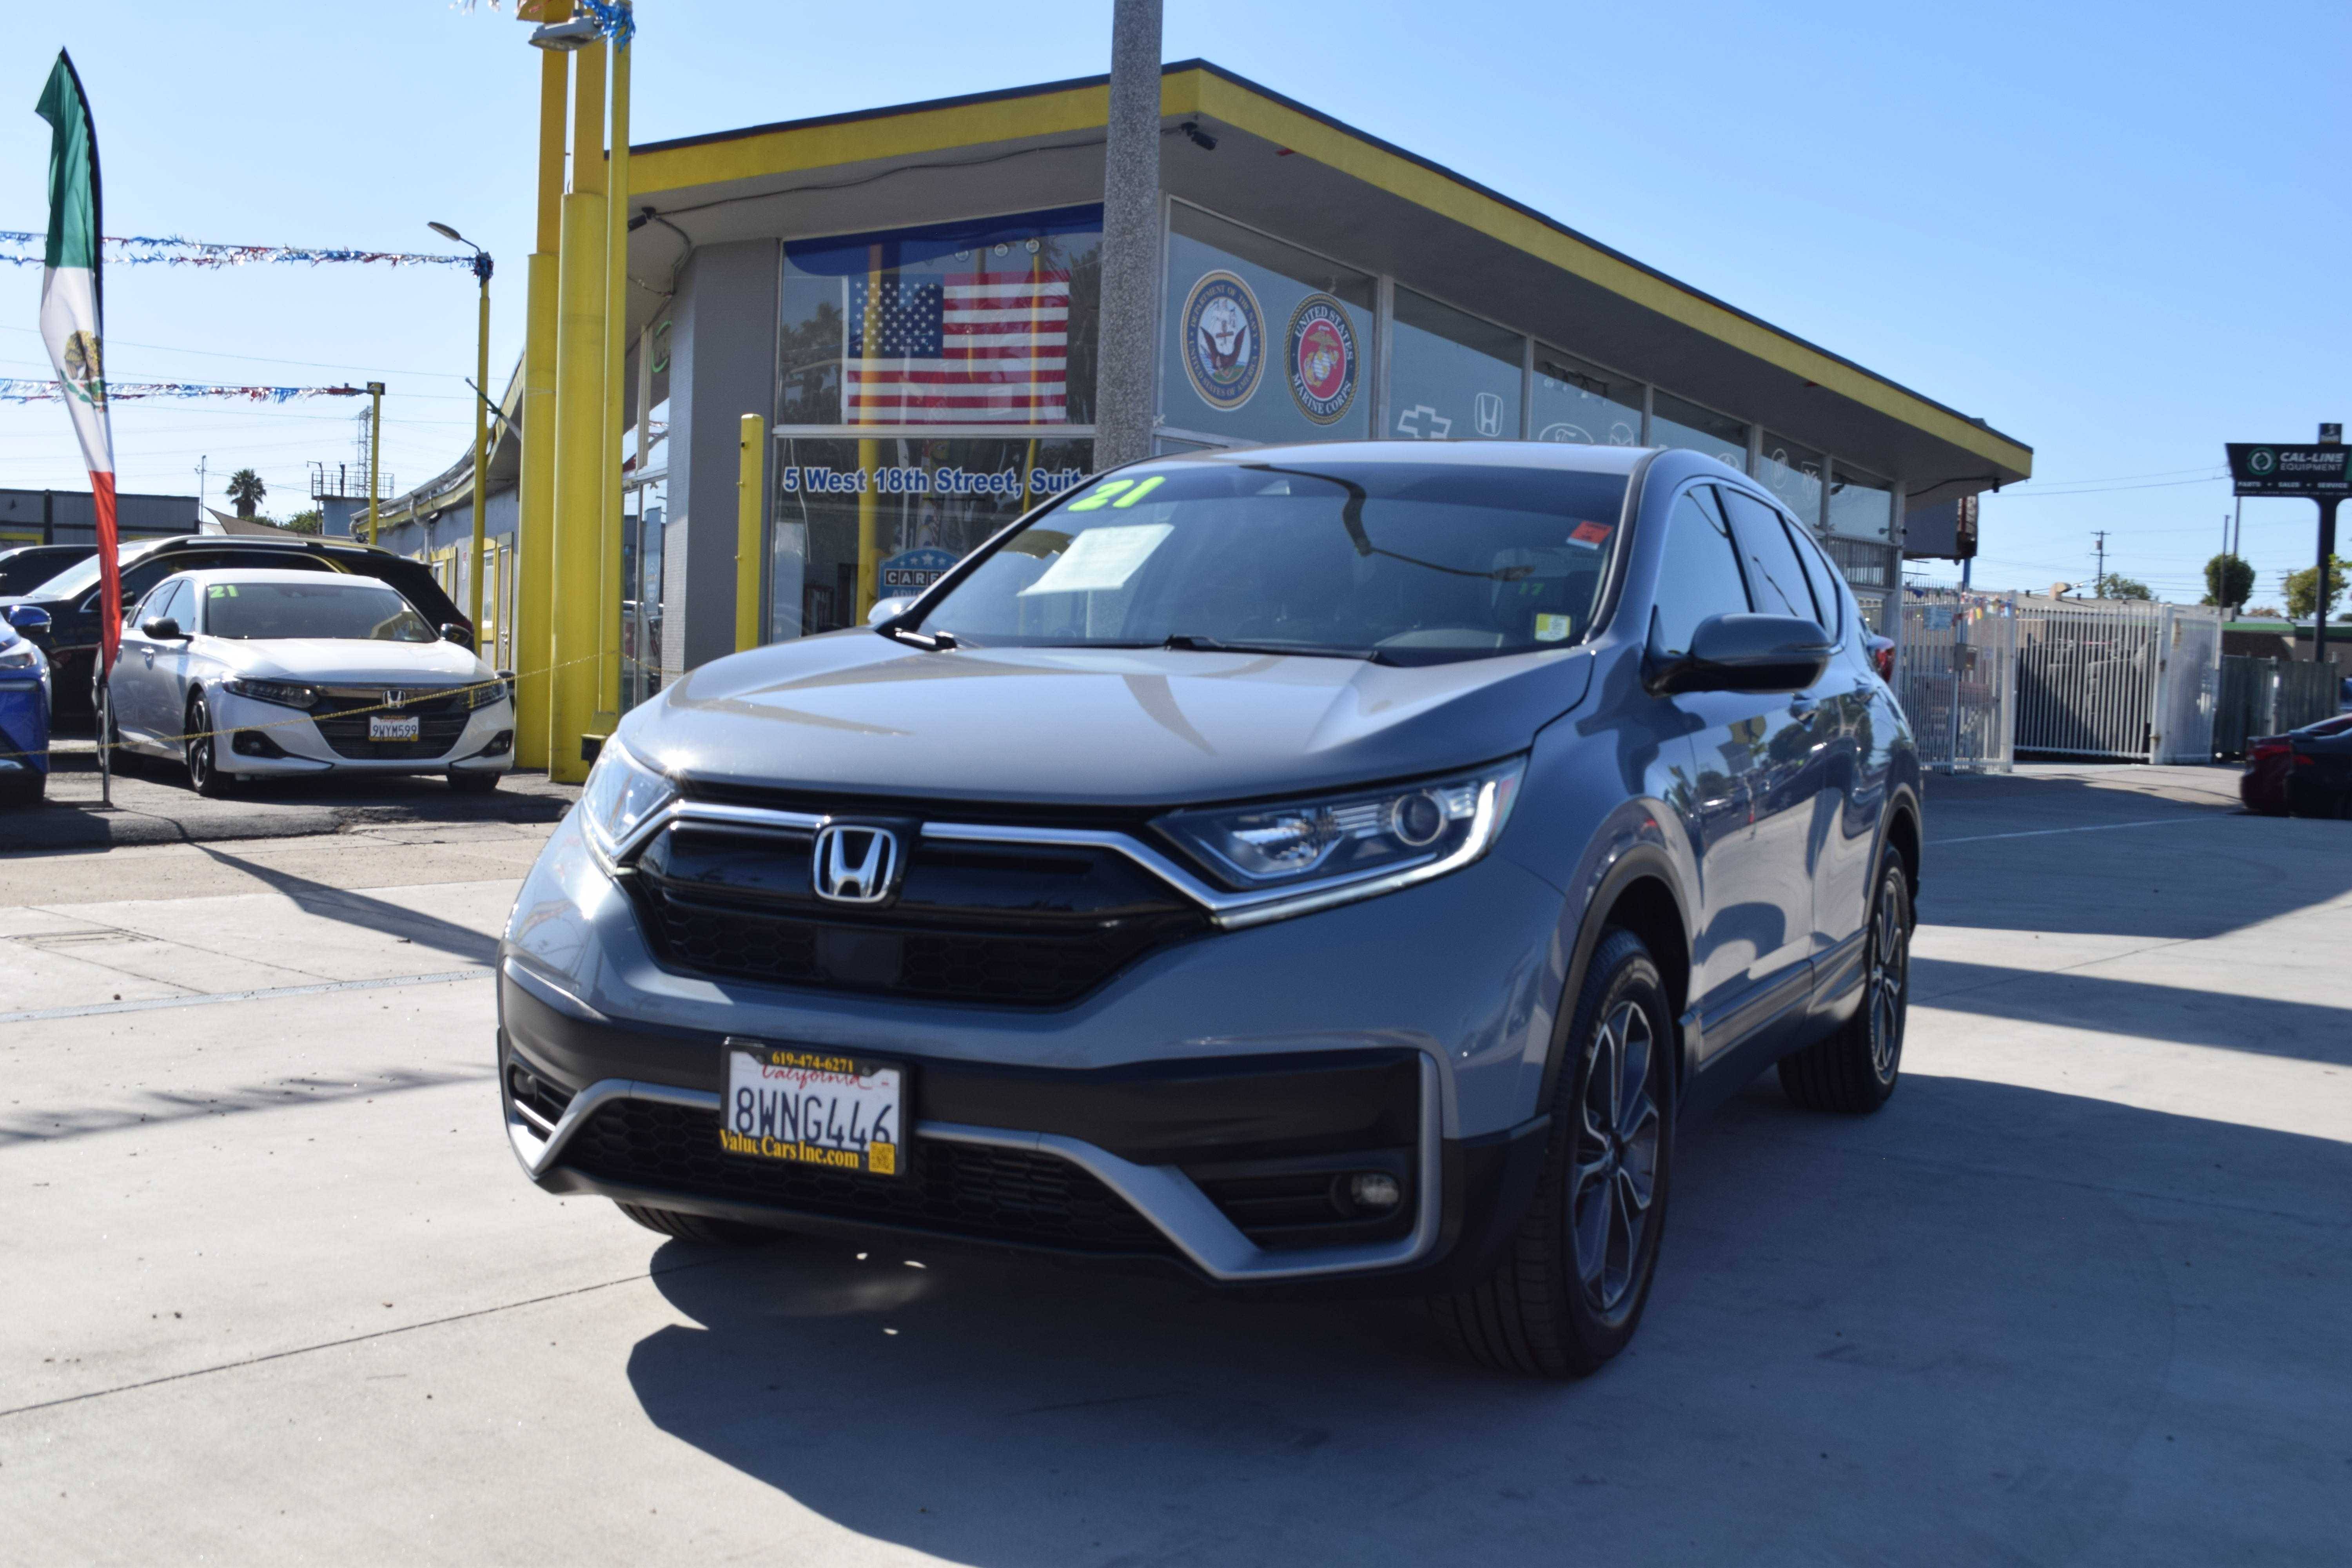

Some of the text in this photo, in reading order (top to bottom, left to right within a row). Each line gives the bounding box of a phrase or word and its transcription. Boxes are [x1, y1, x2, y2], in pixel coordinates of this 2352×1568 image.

[1295, 306, 1353, 360] UNITED STATES
[1293, 373, 1352, 414] MARINE CORPS
[2279, 452, 2344, 462] CAL-LINE
[783, 466, 1088, 499] 5 West 18th Street, Suit
[1068, 475, 1166, 512] 21
[209, 585, 238, 599] 21
[373, 725, 417, 737] 9WYM599
[762, 1064, 873, 1090] California
[772, 1051, 853, 1073] 619-474-6271
[736, 1087, 893, 1148] 8WNG446
[761, 1136, 797, 1160] Cars
[798, 1140, 859, 1168] Inc.com
